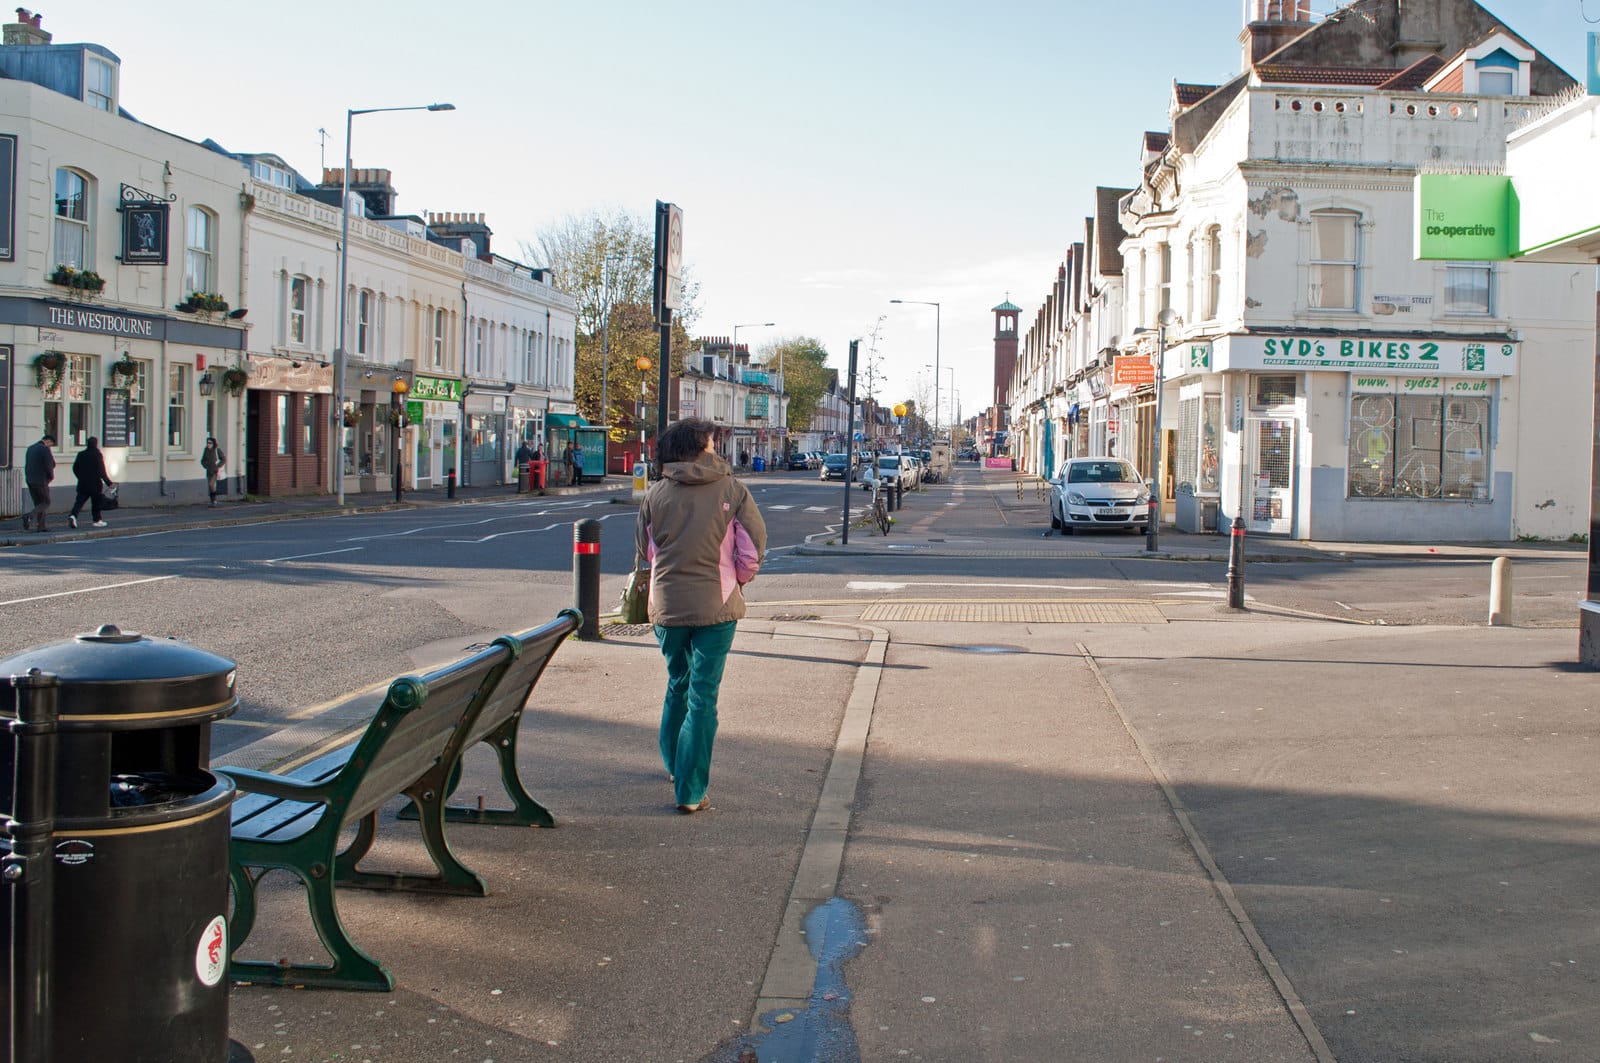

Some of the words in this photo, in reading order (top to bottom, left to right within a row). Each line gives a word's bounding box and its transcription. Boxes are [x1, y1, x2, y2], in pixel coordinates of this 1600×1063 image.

[1426, 208, 1445, 221] The
[1427, 224, 1495, 238] co-operative
[49, 307, 74, 326] THE
[77, 311, 152, 335] WESTBOURNE
[1264, 338, 1325, 357] SYD's
[1340, 340, 1411, 360] BIKES
[1418, 342, 1439, 361] 2
[1357, 378, 1389, 388] www.
[1404, 377, 1440, 391] syds2
[1451, 380, 1488, 391] .co.uk
